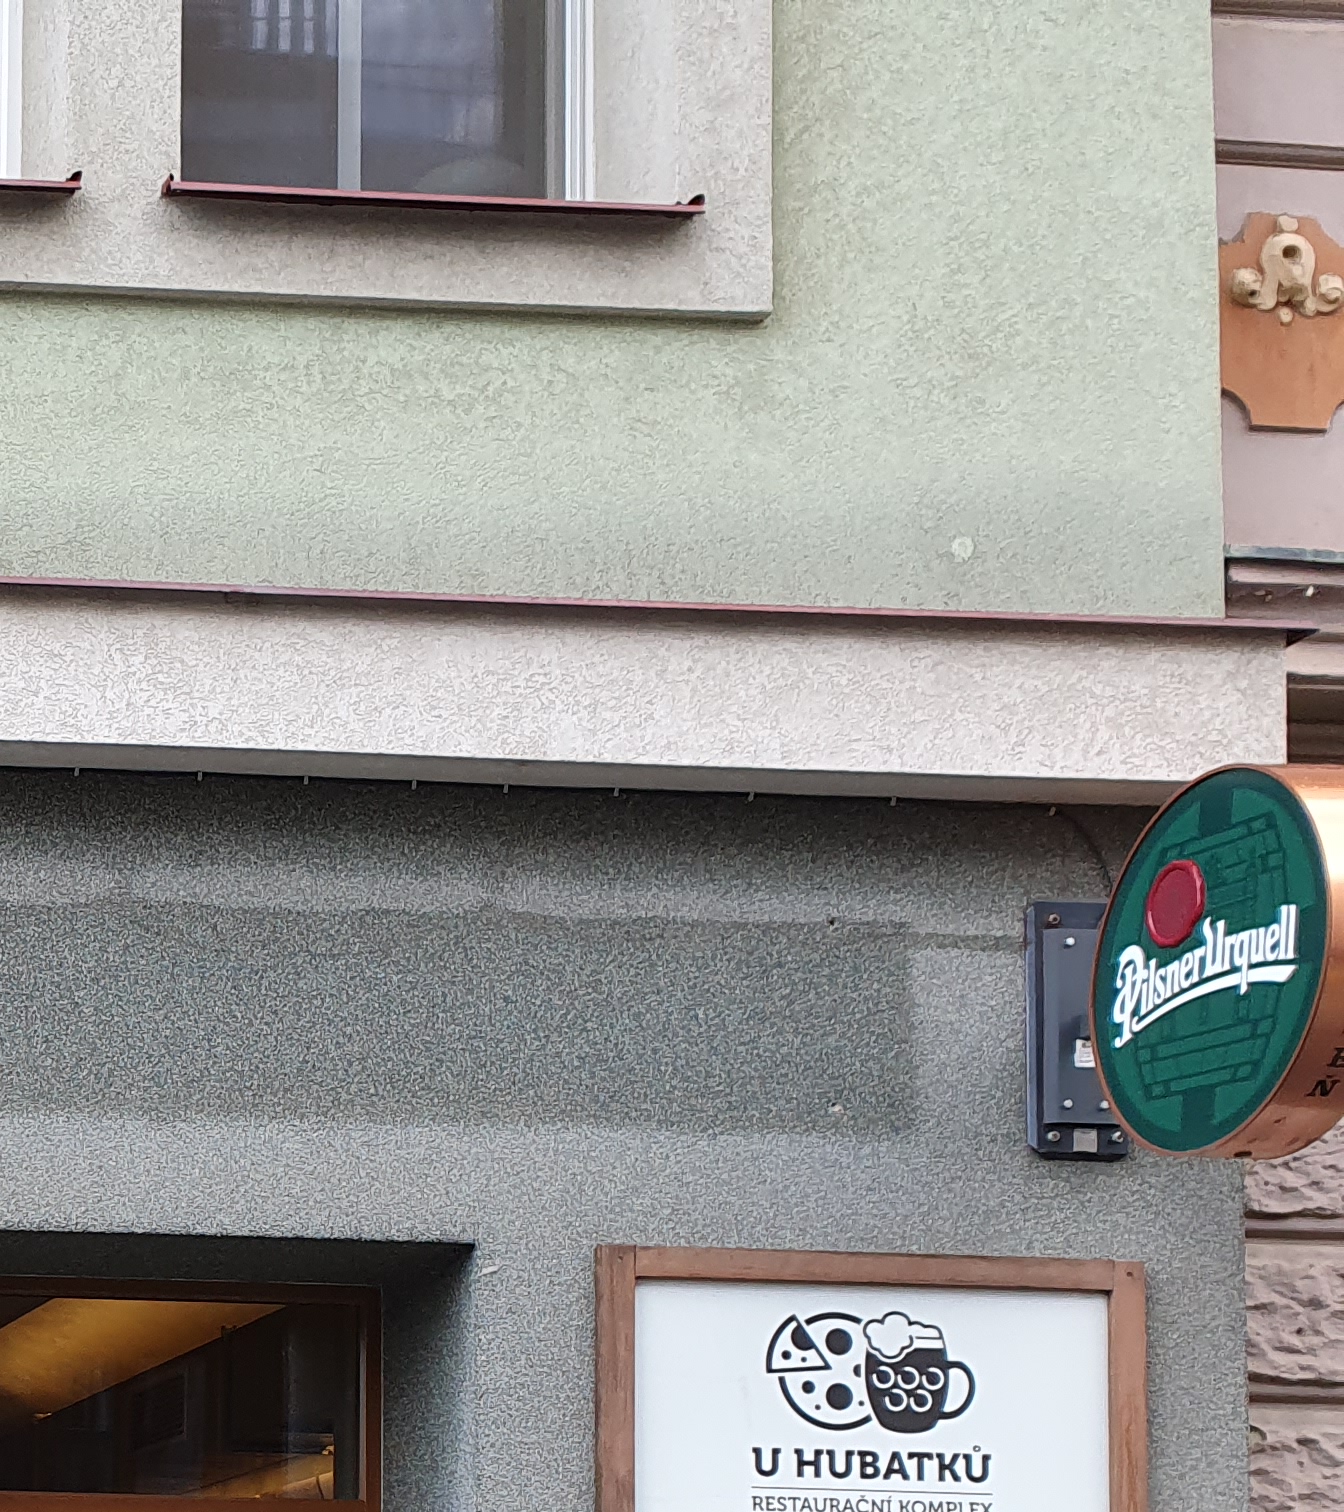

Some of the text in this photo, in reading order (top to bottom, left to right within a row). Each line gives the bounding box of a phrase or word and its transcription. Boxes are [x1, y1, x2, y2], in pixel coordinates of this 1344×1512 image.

[1113, 904, 1299, 1049] Pilsner Urquell
[751, 1445, 992, 1484] U HUBATKŮ
